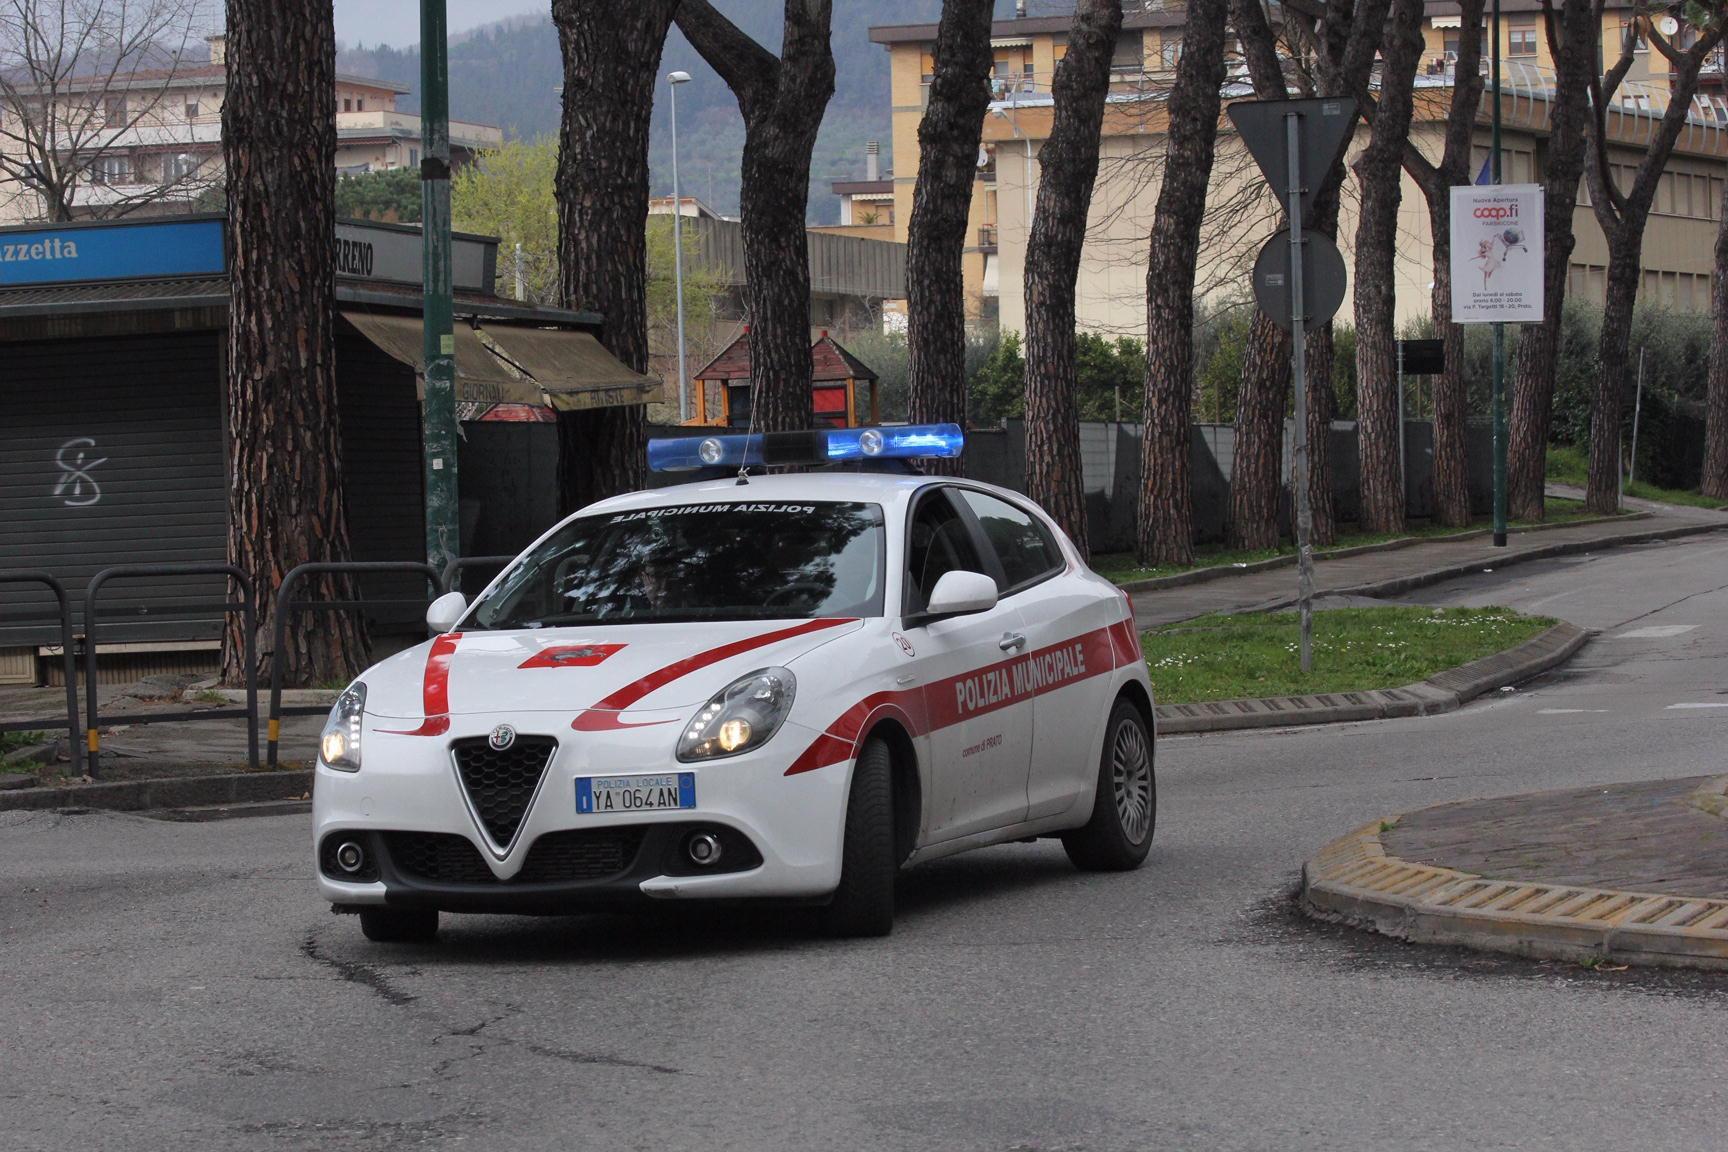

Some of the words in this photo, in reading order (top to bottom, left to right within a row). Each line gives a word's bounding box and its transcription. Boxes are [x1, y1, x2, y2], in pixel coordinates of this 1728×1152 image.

[1473, 204, 1519, 220] coop.fi
[0, 238, 78, 262] zzetta
[955, 668, 1011, 714] POLIZIA
[1013, 643, 1085, 697] MUNICIPALE
[962, 743, 980, 758] comune
[986, 734, 1002, 750] PRATO
[597, 780, 631, 789] POLIZIA
[637, 777, 672, 787] LOCALE
